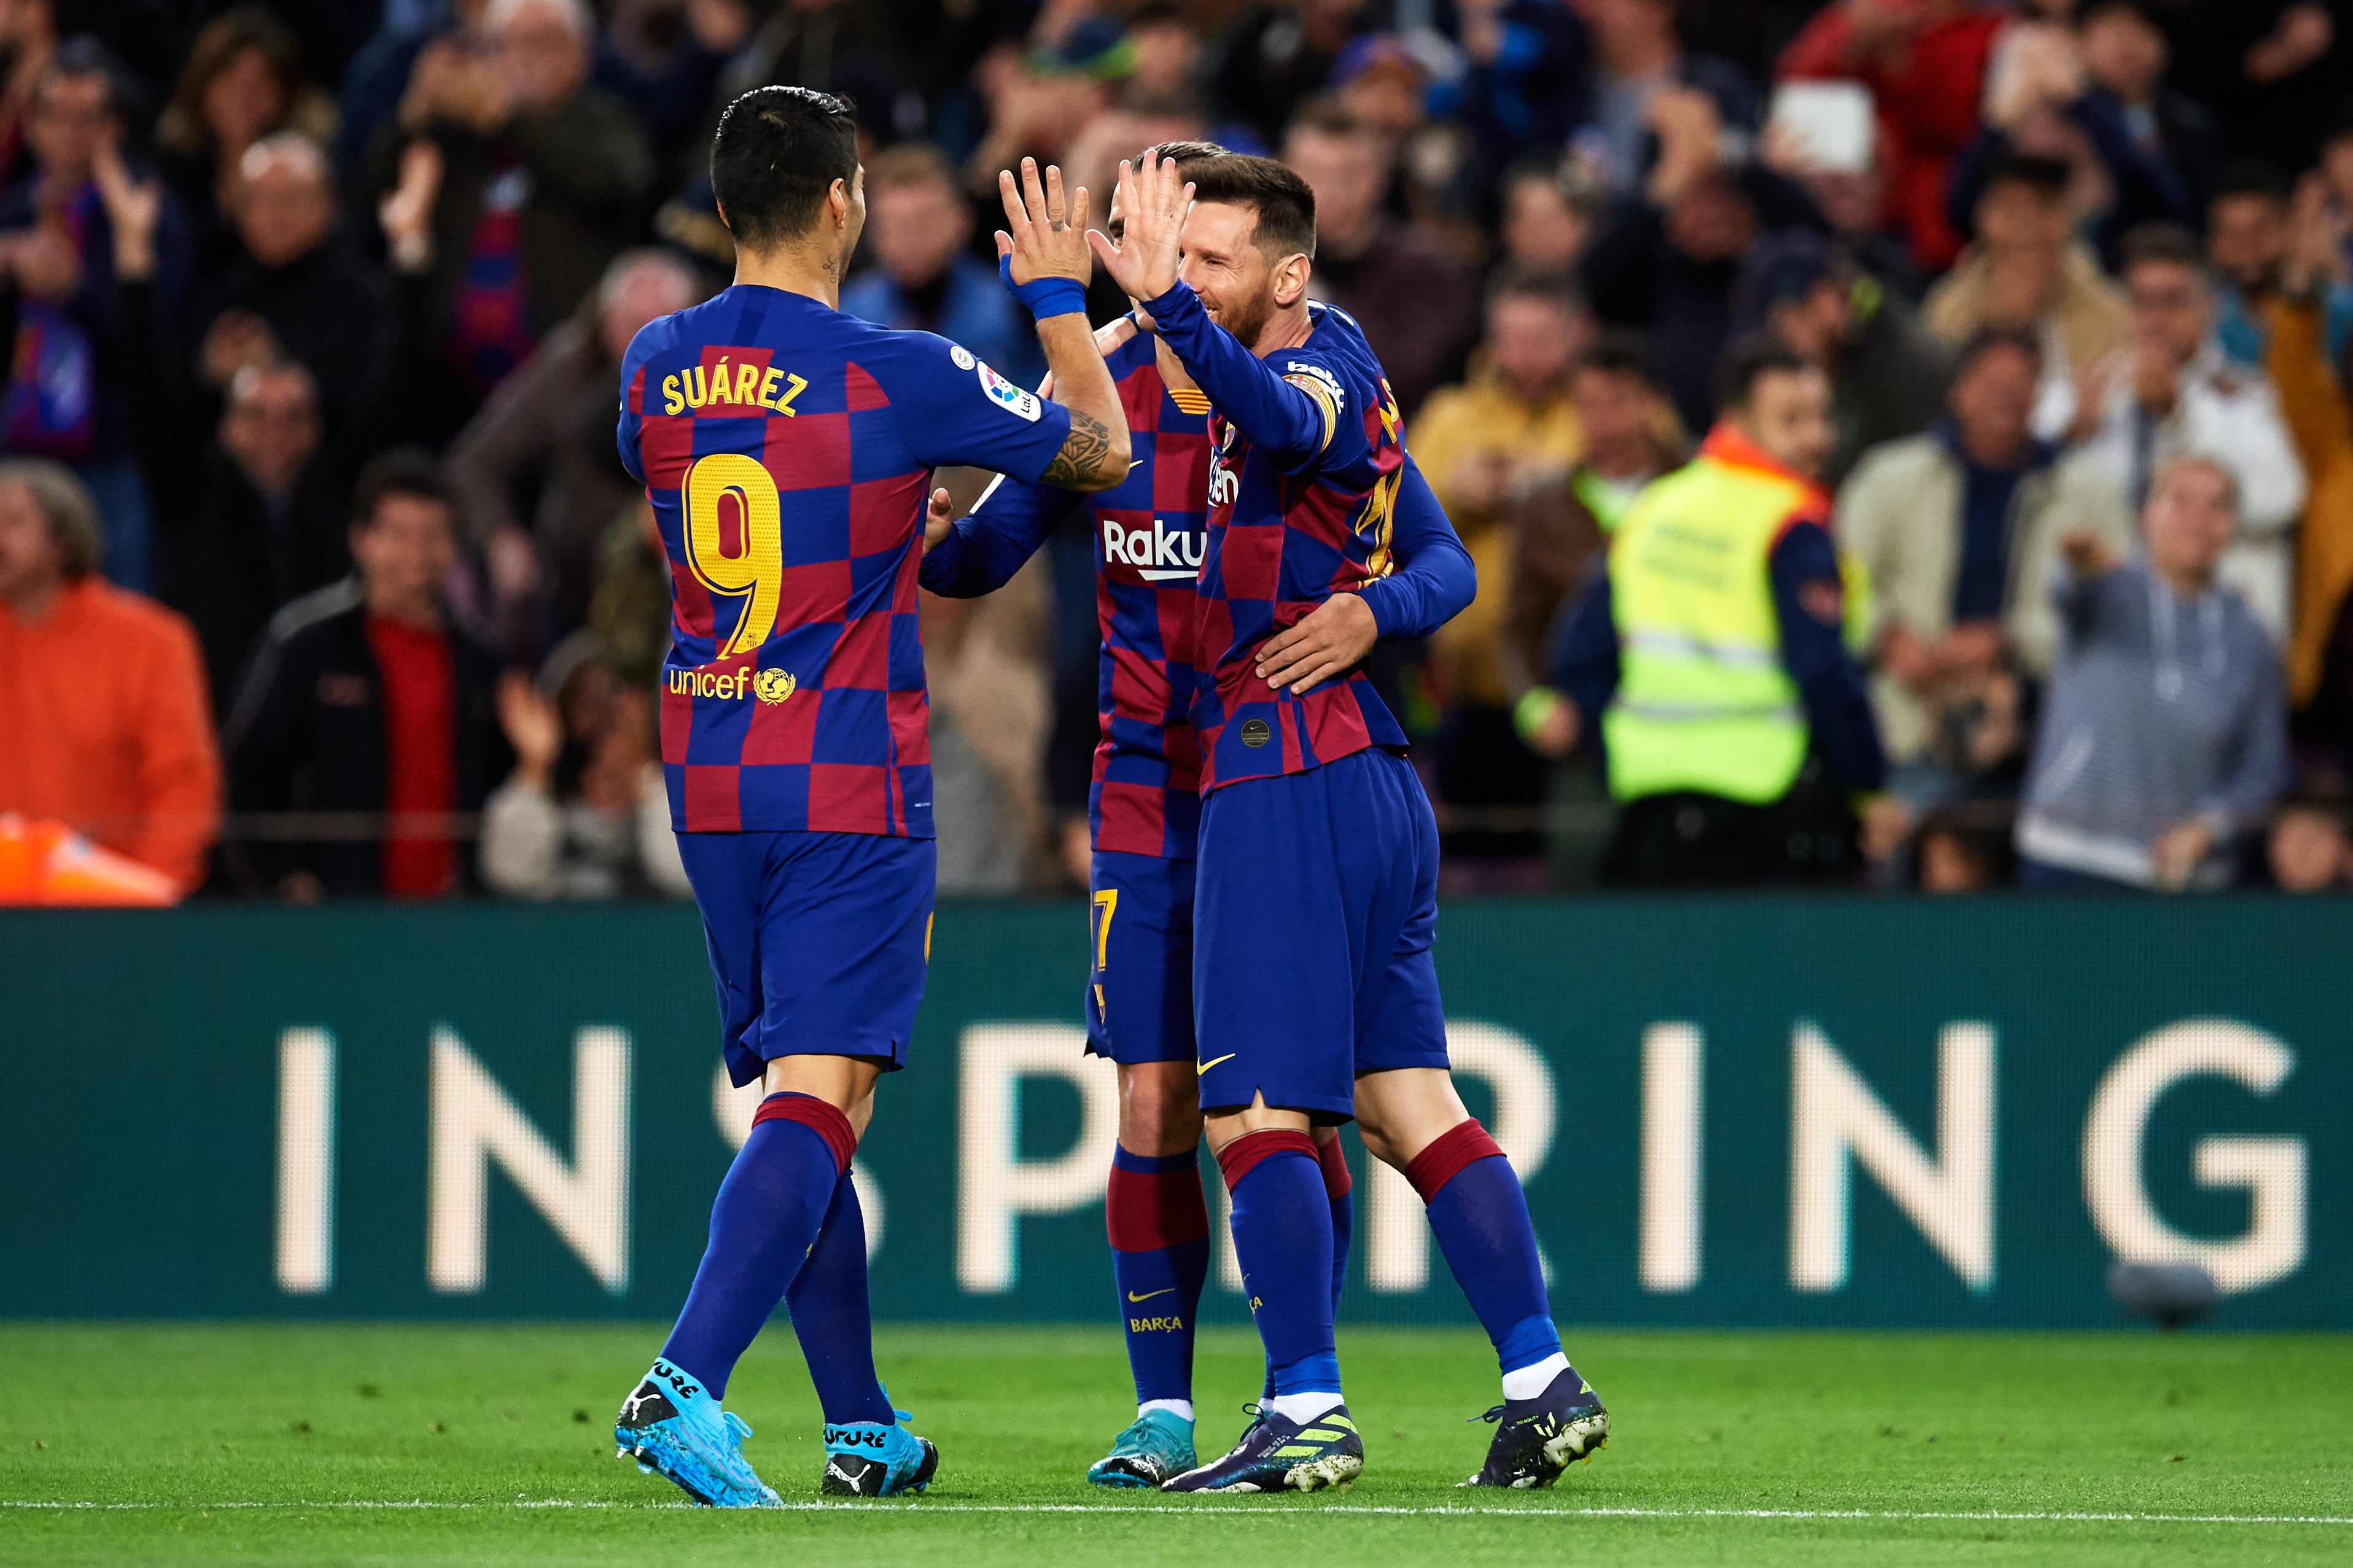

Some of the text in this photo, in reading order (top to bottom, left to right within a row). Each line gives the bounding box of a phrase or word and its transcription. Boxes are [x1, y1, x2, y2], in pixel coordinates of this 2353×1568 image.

[663, 356, 808, 417] SUÁREZ
[682, 453, 782, 661] 9
[670, 664, 750, 700] unicef
[1130, 1316, 1183, 1333] BARÇA
[823, 1429, 886, 1448] UTURE
